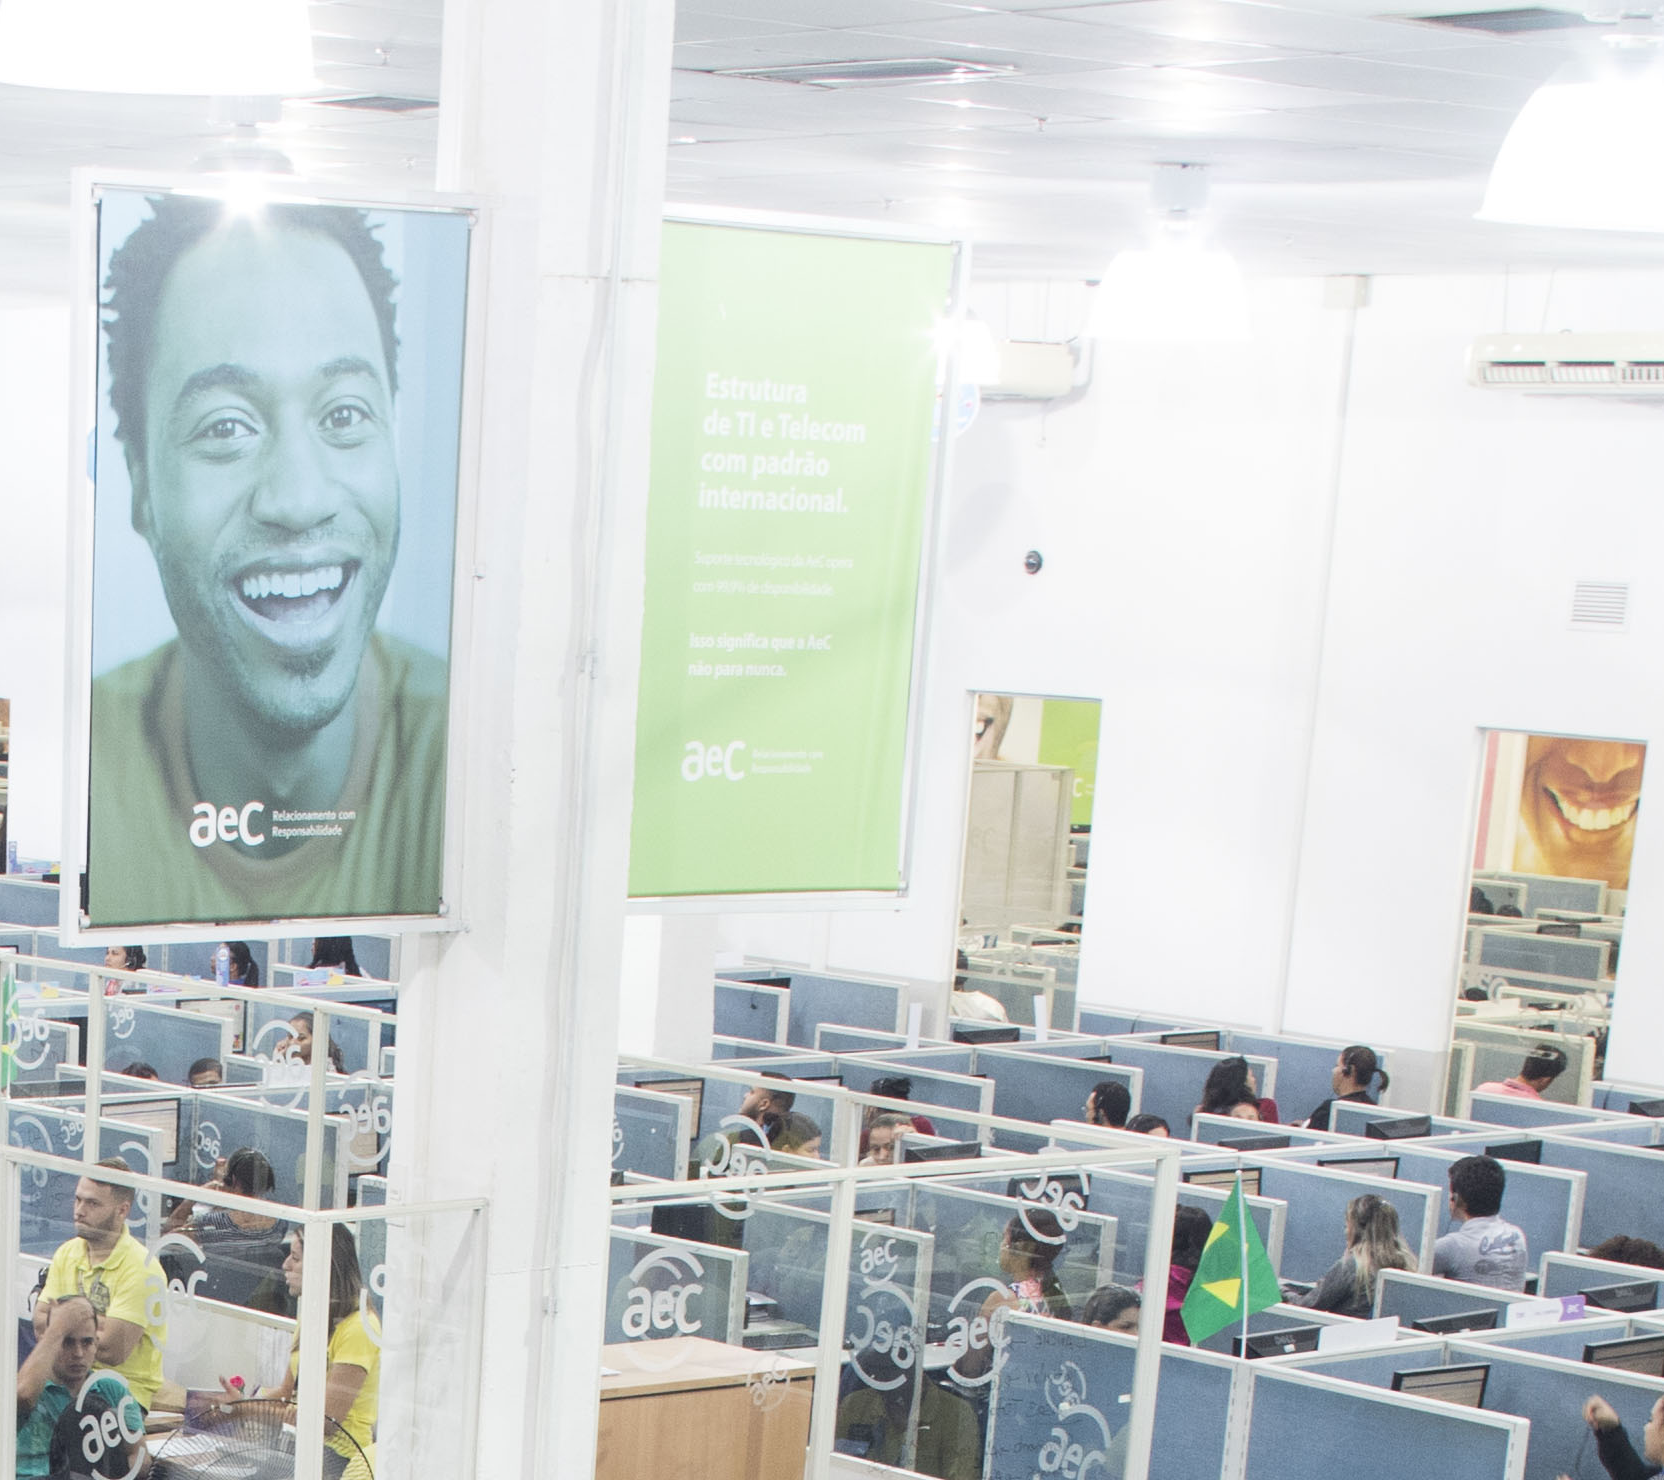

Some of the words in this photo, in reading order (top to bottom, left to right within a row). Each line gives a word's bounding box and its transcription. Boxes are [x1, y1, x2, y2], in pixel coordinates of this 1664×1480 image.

[705, 372, 808, 404] Estrutura
[703, 408, 732, 437] de
[735, 411, 757, 439] TI
[760, 418, 775, 439] e
[777, 412, 868, 444] Telecom
[701, 450, 747, 473] com
[752, 448, 831, 481] padrão
[697, 482, 850, 513] internacional.
[689, 632, 715, 649] Isso
[716, 632, 769, 652] significa
[771, 636, 796, 653] que
[797, 638, 806, 650] a
[806, 633, 833, 651] AeC
[688, 660, 713, 677] não
[714, 662, 744, 680] para
[745, 663, 787, 677] nunca.
[272, 809, 337, 822] Relacionamento
[338, 810, 357, 821] com
[272, 824, 343, 839] Responsabilidade
